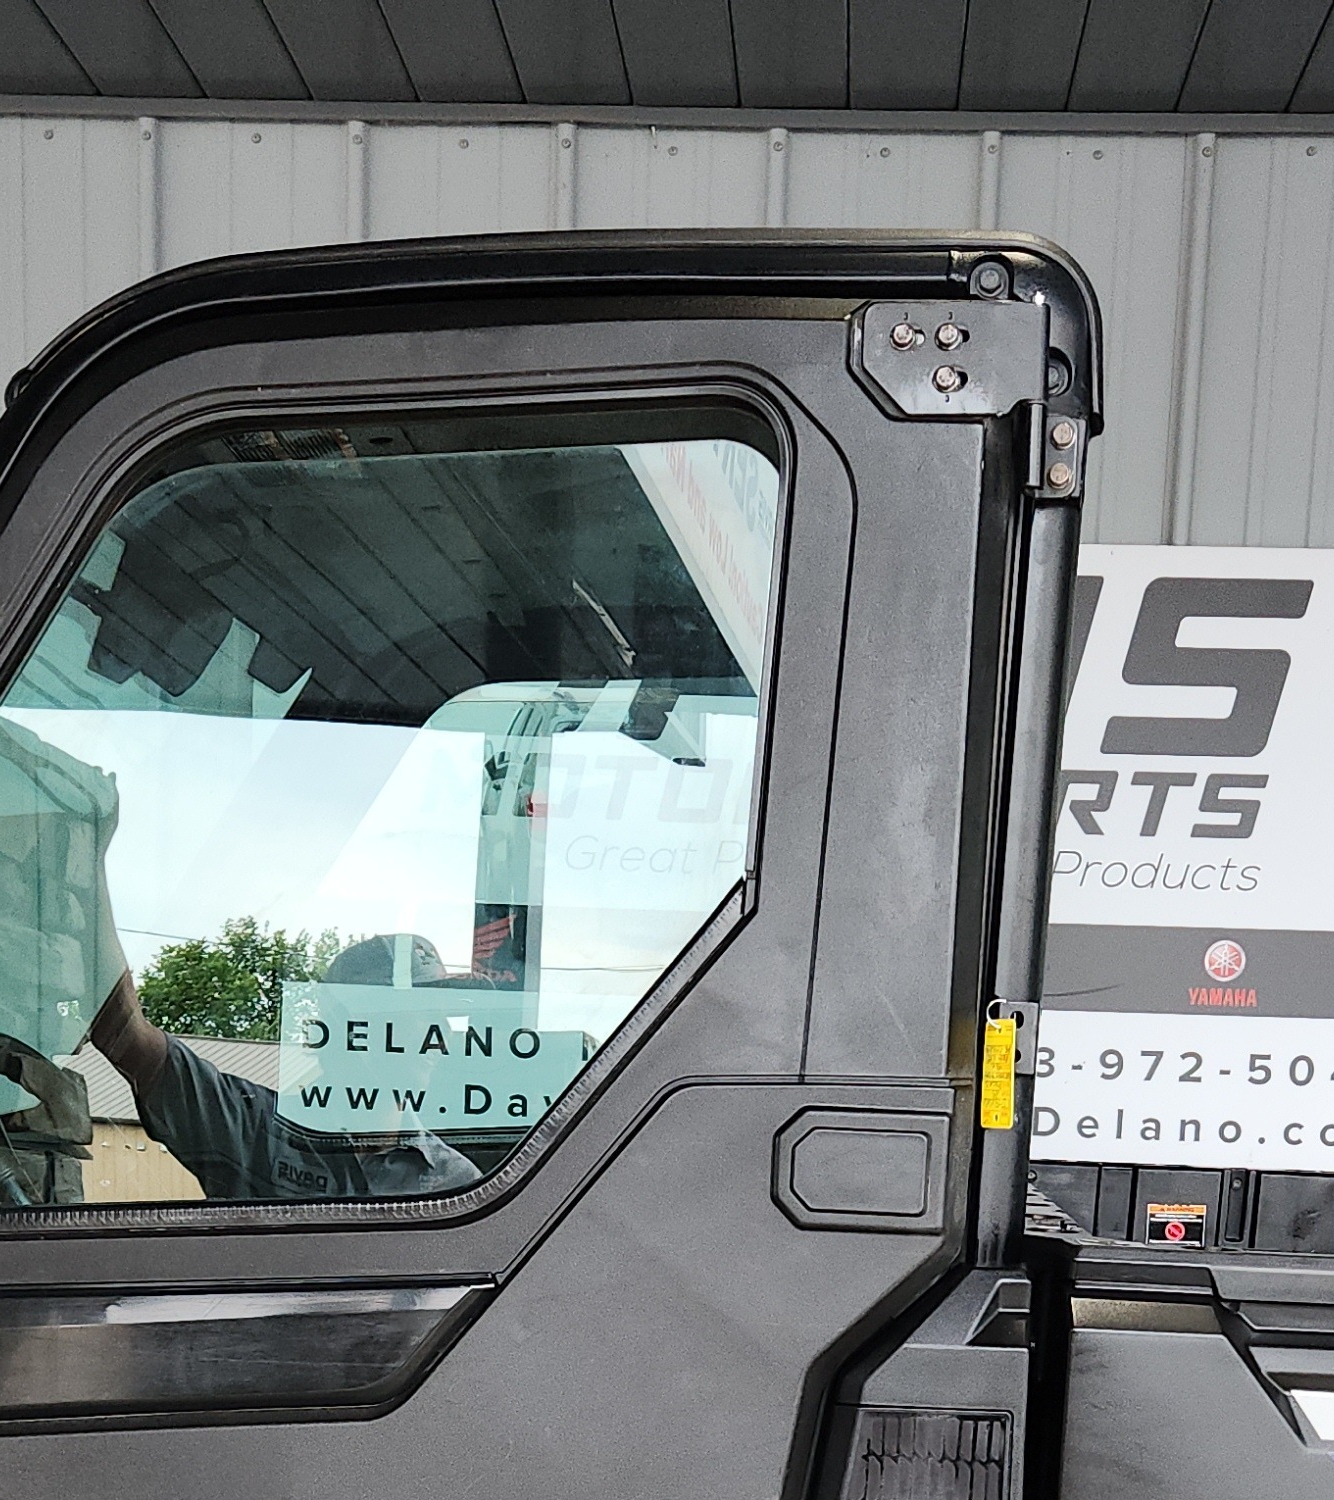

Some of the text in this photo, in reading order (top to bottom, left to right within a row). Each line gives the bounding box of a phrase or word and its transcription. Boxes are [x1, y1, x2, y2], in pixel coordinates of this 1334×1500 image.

[564, 835, 697, 874] Great
[1053, 850, 1261, 892] Products
[1188, 987, 1258, 1008] YAMAHA
[301, 1018, 541, 1060] DELANO
